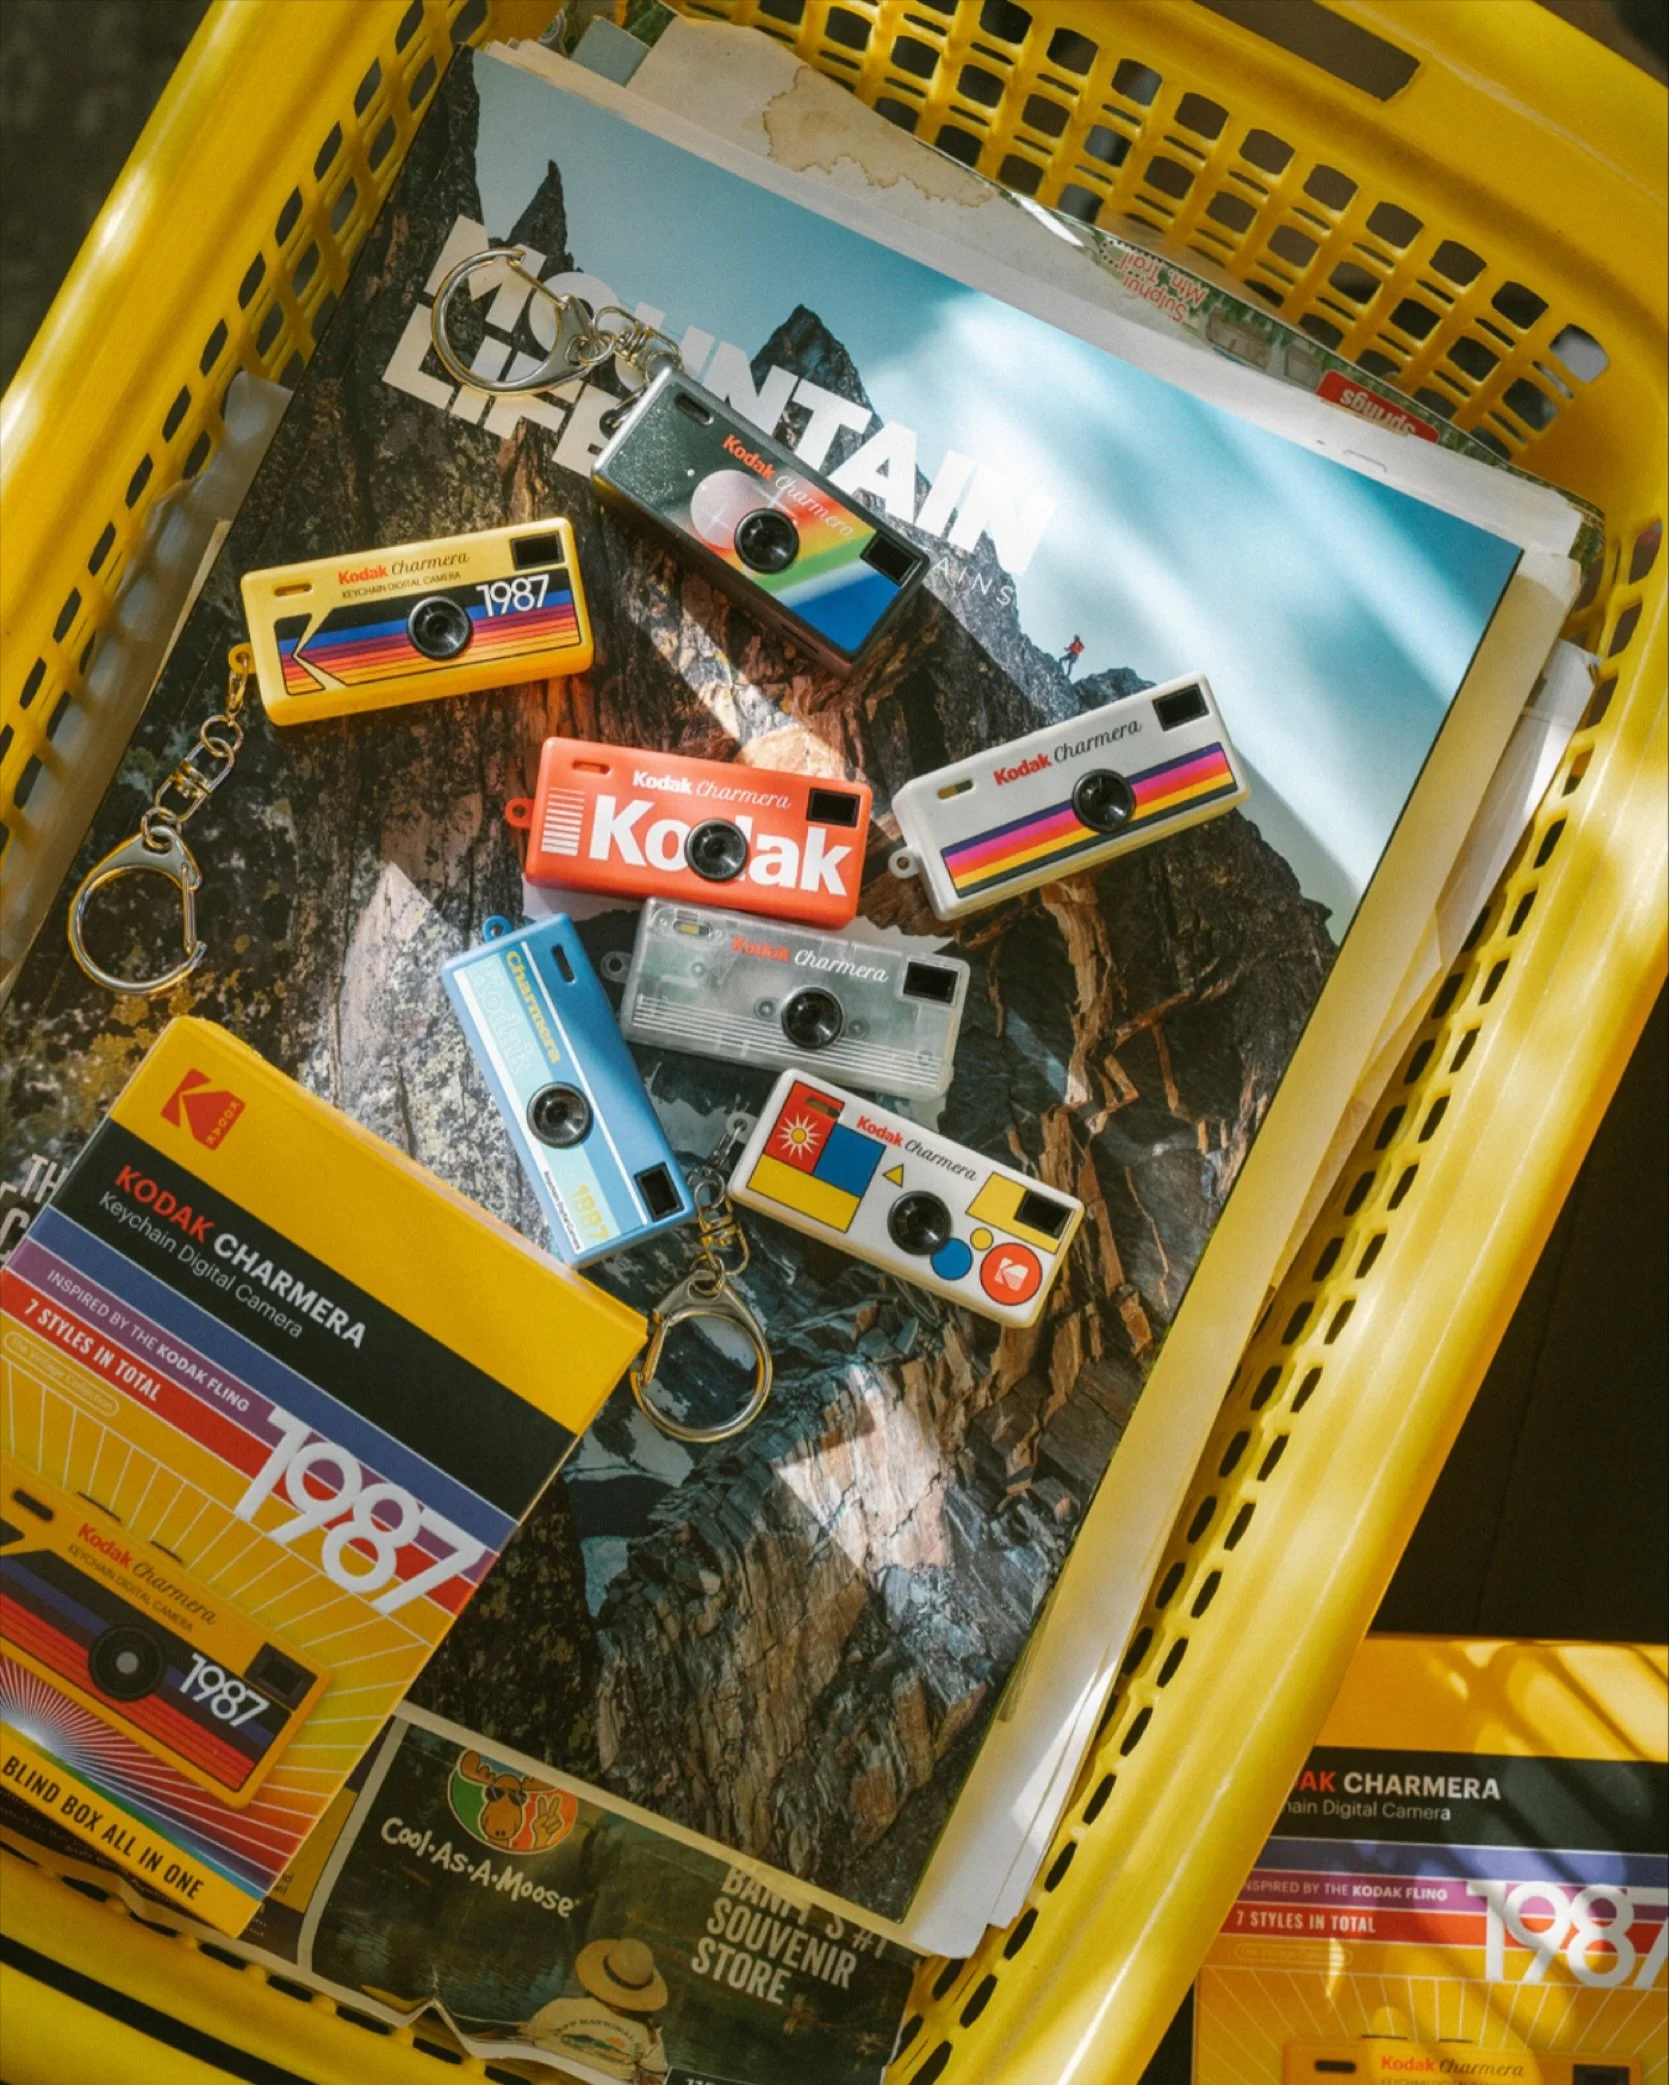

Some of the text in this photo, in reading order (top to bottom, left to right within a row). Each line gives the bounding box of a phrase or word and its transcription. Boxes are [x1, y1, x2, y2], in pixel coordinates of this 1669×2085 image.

[721, 433, 856, 537] Kodak Charmera
[337, 551, 470, 585] Kodak Charmera
[342, 571, 461, 600] KEYCHAIN DIGITAL CAMERA
[475, 574, 551, 617] 1987
[993, 719, 1142, 786] Kodak Charmera
[632, 769, 792, 810] Kodak Charmera
[731, 935, 890, 984] Kodak Charmera
[506, 950, 560, 1064] Charmera
[856, 1115, 978, 1182] Kodak Charmera
[100, 1191, 304, 1338] Keychain Digital Camera
[115, 1165, 215, 1243] KODAK
[213, 1233, 367, 1349] CHARMERA
[24, 1298, 162, 1402] 7 STYLES IN TOTAL
[47, 1269, 250, 1413] INSPIRED BY THE KODAK FLING
[234, 1406, 486, 1616] 1987
[68, 1544, 194, 1632] KEYCHAIN DIGITAL CAMERA
[78, 1523, 217, 1625] Kodak Charmera
[179, 1652, 270, 1727] 1987
[1323, 1799, 1377, 1819] Digital
[1382, 1802, 1451, 1821] Camera
[1343, 1771, 1501, 1800] CHARMERA
[2, 1755, 61, 1803] BLIND
[61, 1794, 103, 1833] BOX
[101, 1824, 136, 1857] ALL
[138, 1846, 164, 1873] IN
[163, 1864, 205, 1900] ONE
[1236, 1911, 1376, 1933] 7 STYLES IN TOTAL
[1245, 1879, 1448, 1901] NSPIRED BY THE KODAK FLING
[691, 1937, 792, 2005] STORE
[707, 1897, 857, 1990] SOUVENIR
[1381, 2055, 1524, 2076] Kodak Charmera
